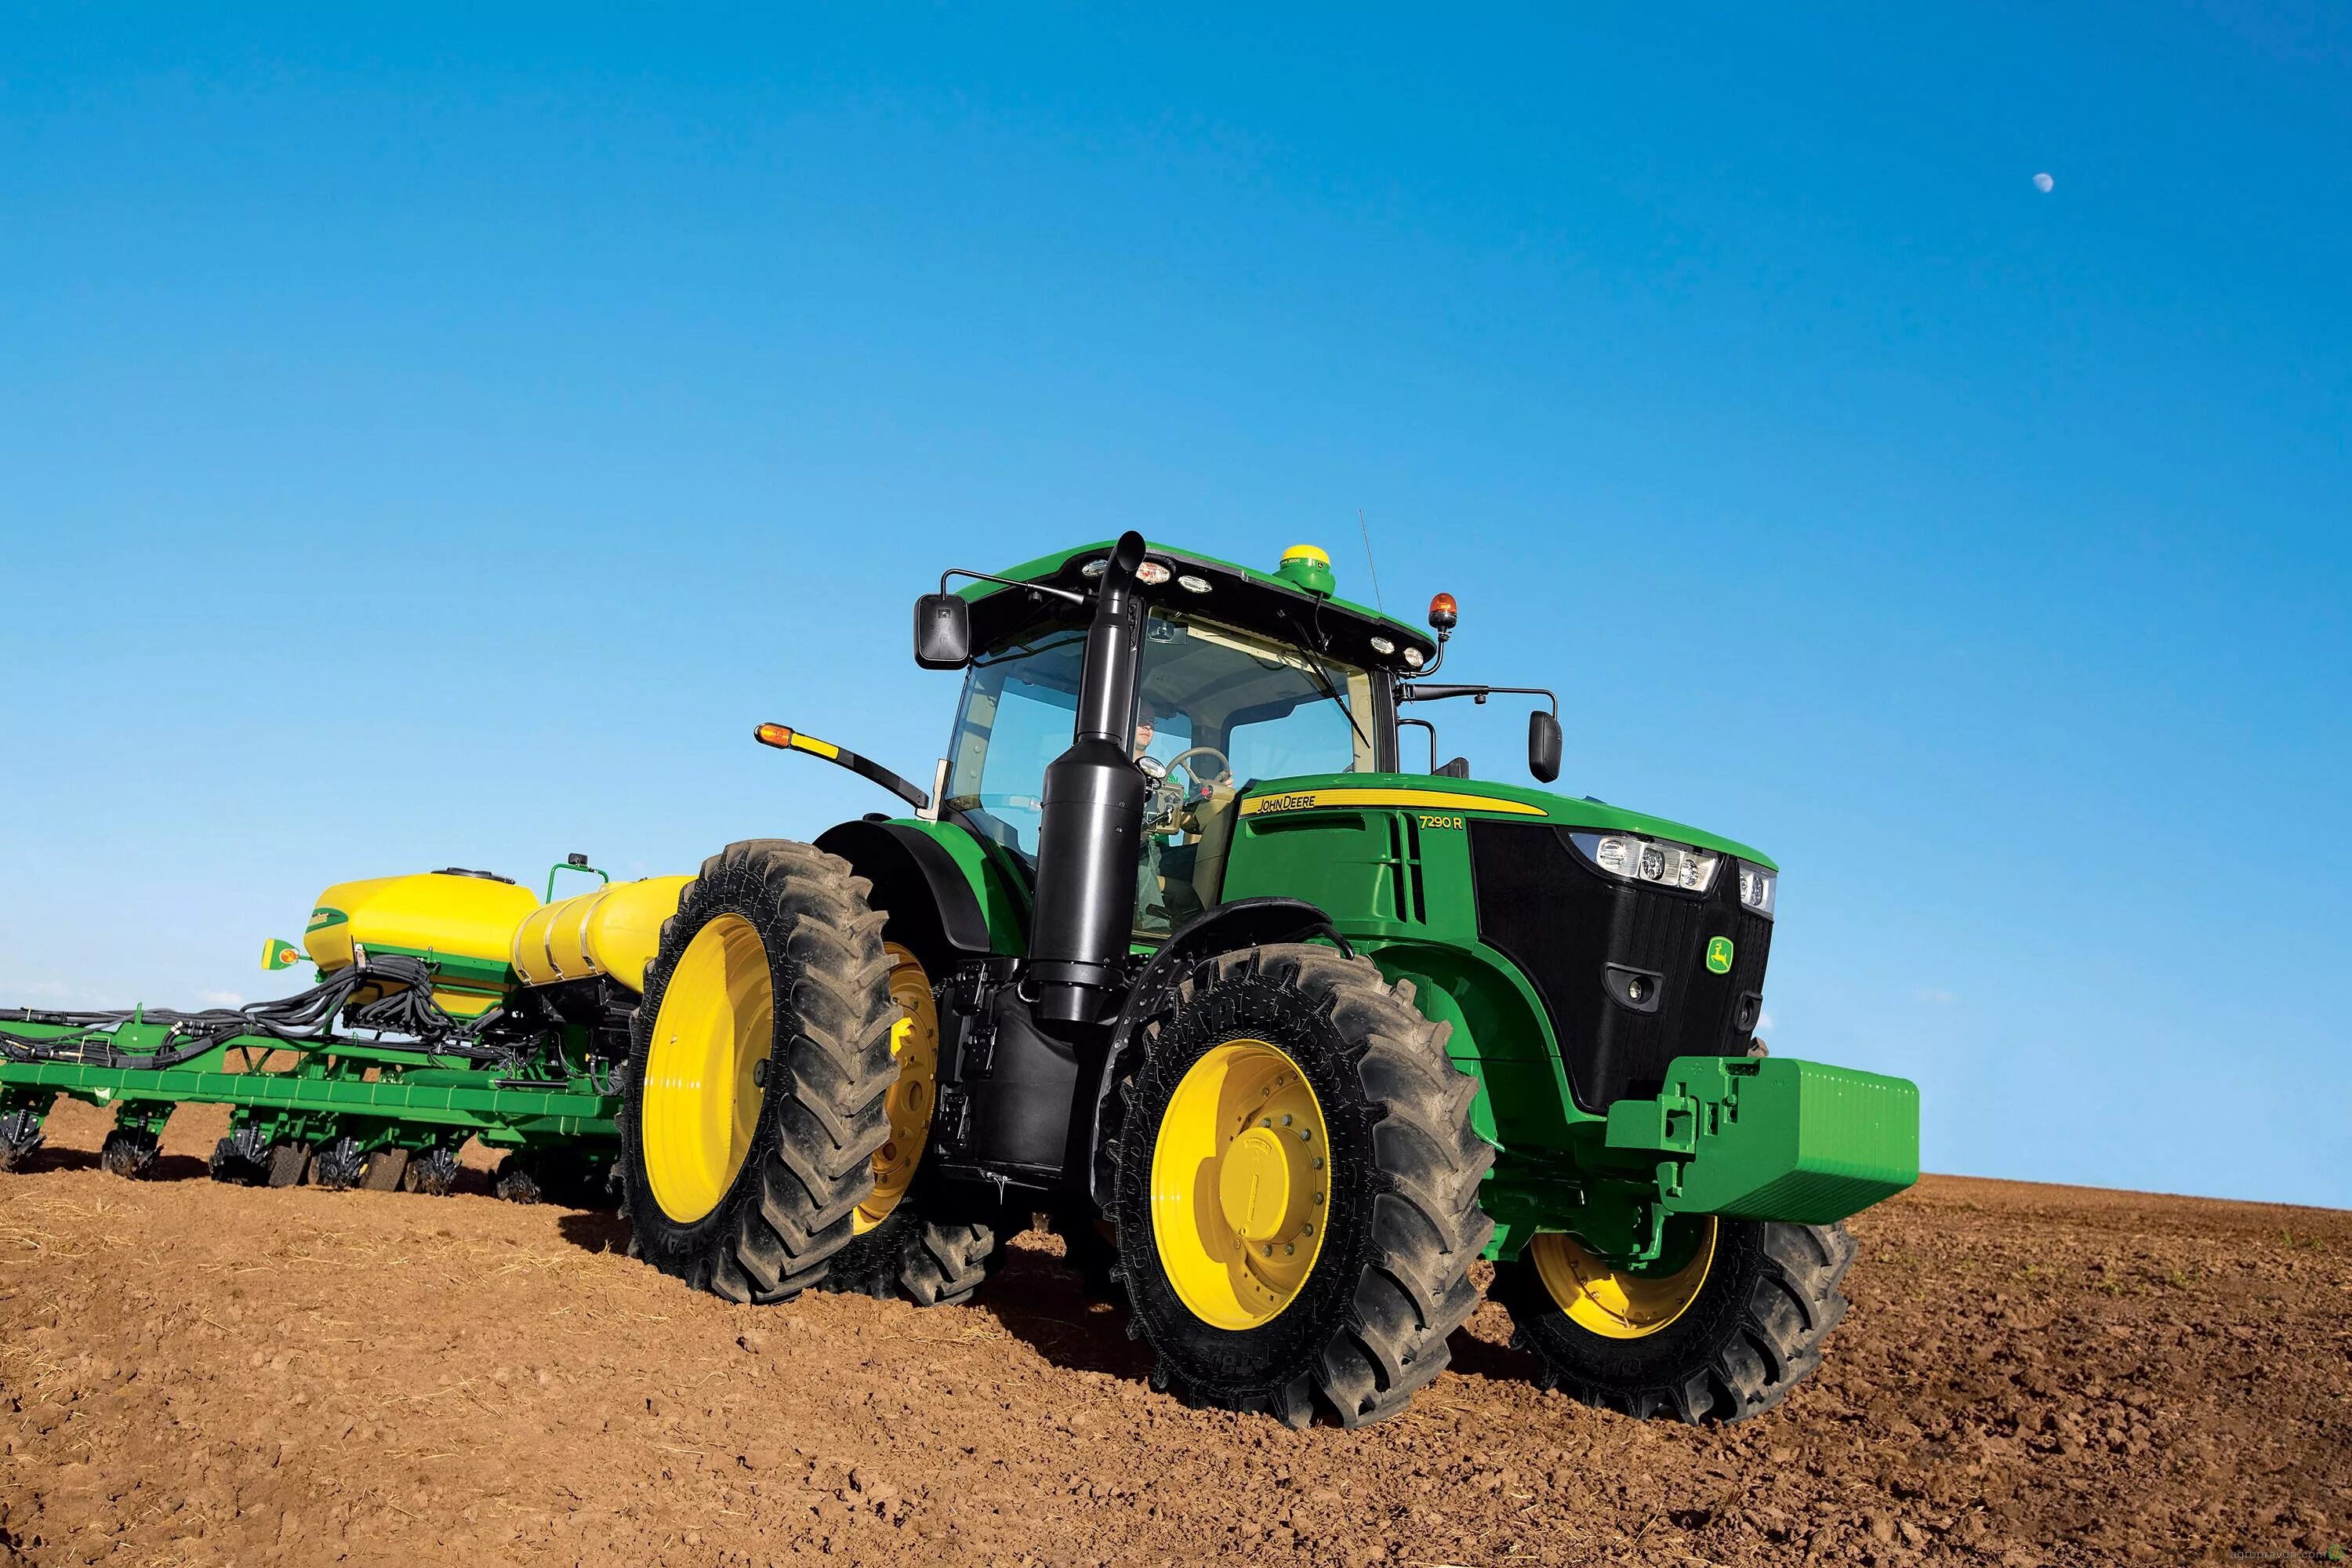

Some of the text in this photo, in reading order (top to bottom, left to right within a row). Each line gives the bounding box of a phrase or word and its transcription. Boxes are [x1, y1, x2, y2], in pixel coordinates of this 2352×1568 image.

[1257, 795, 1316, 812] JOHN DEERE
[1419, 815, 1463, 829] 7290 R
